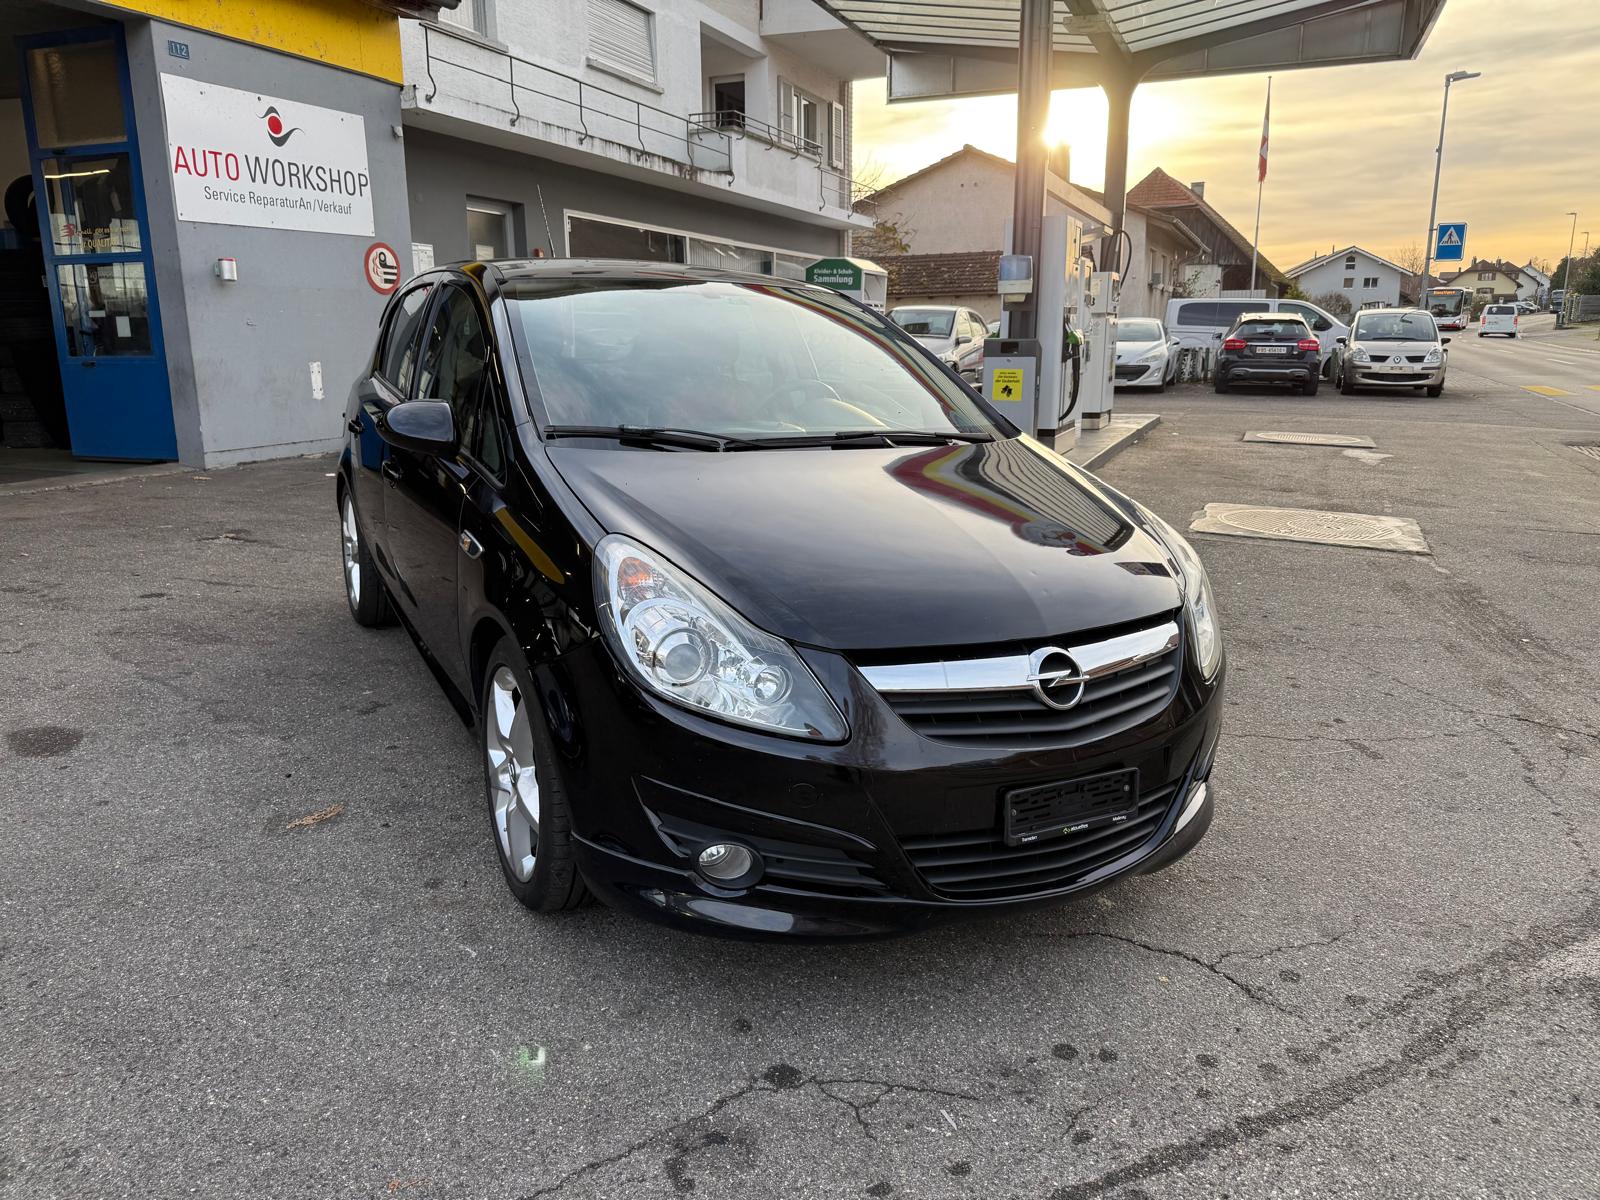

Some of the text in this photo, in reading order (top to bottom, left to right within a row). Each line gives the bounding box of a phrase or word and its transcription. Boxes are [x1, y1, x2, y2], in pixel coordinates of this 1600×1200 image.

[171, 43, 187, 56] 112
[174, 146, 369, 197] AUTO WORKSHOP
[204, 186, 246, 204] Service
[813, 275, 853, 285] Sammlung
